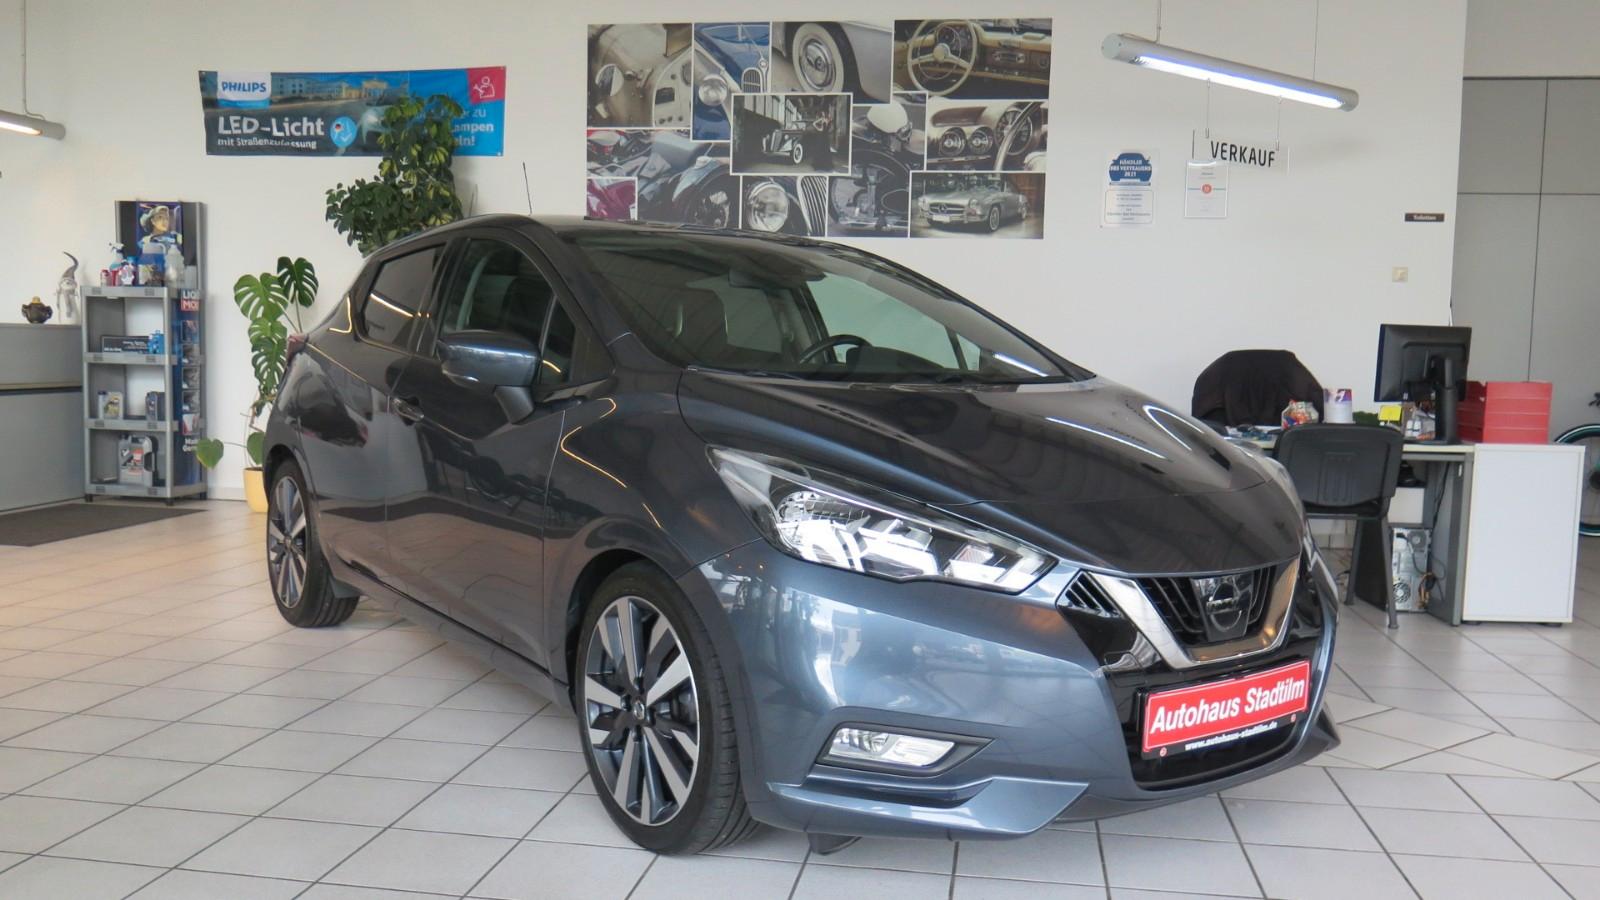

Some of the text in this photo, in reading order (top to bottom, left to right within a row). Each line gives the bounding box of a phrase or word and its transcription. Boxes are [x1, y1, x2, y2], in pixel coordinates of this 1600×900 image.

[221, 81, 267, 93] PHILIPS
[217, 115, 325, 137] LED-Licht
[217, 137, 234, 147] mit
[1210, 140, 1276, 168] VERKAUF
[1150, 676, 1305, 734] Autohaus Stadtilm
[1184, 721, 1278, 751] www.autohaus-stadtilm.de
